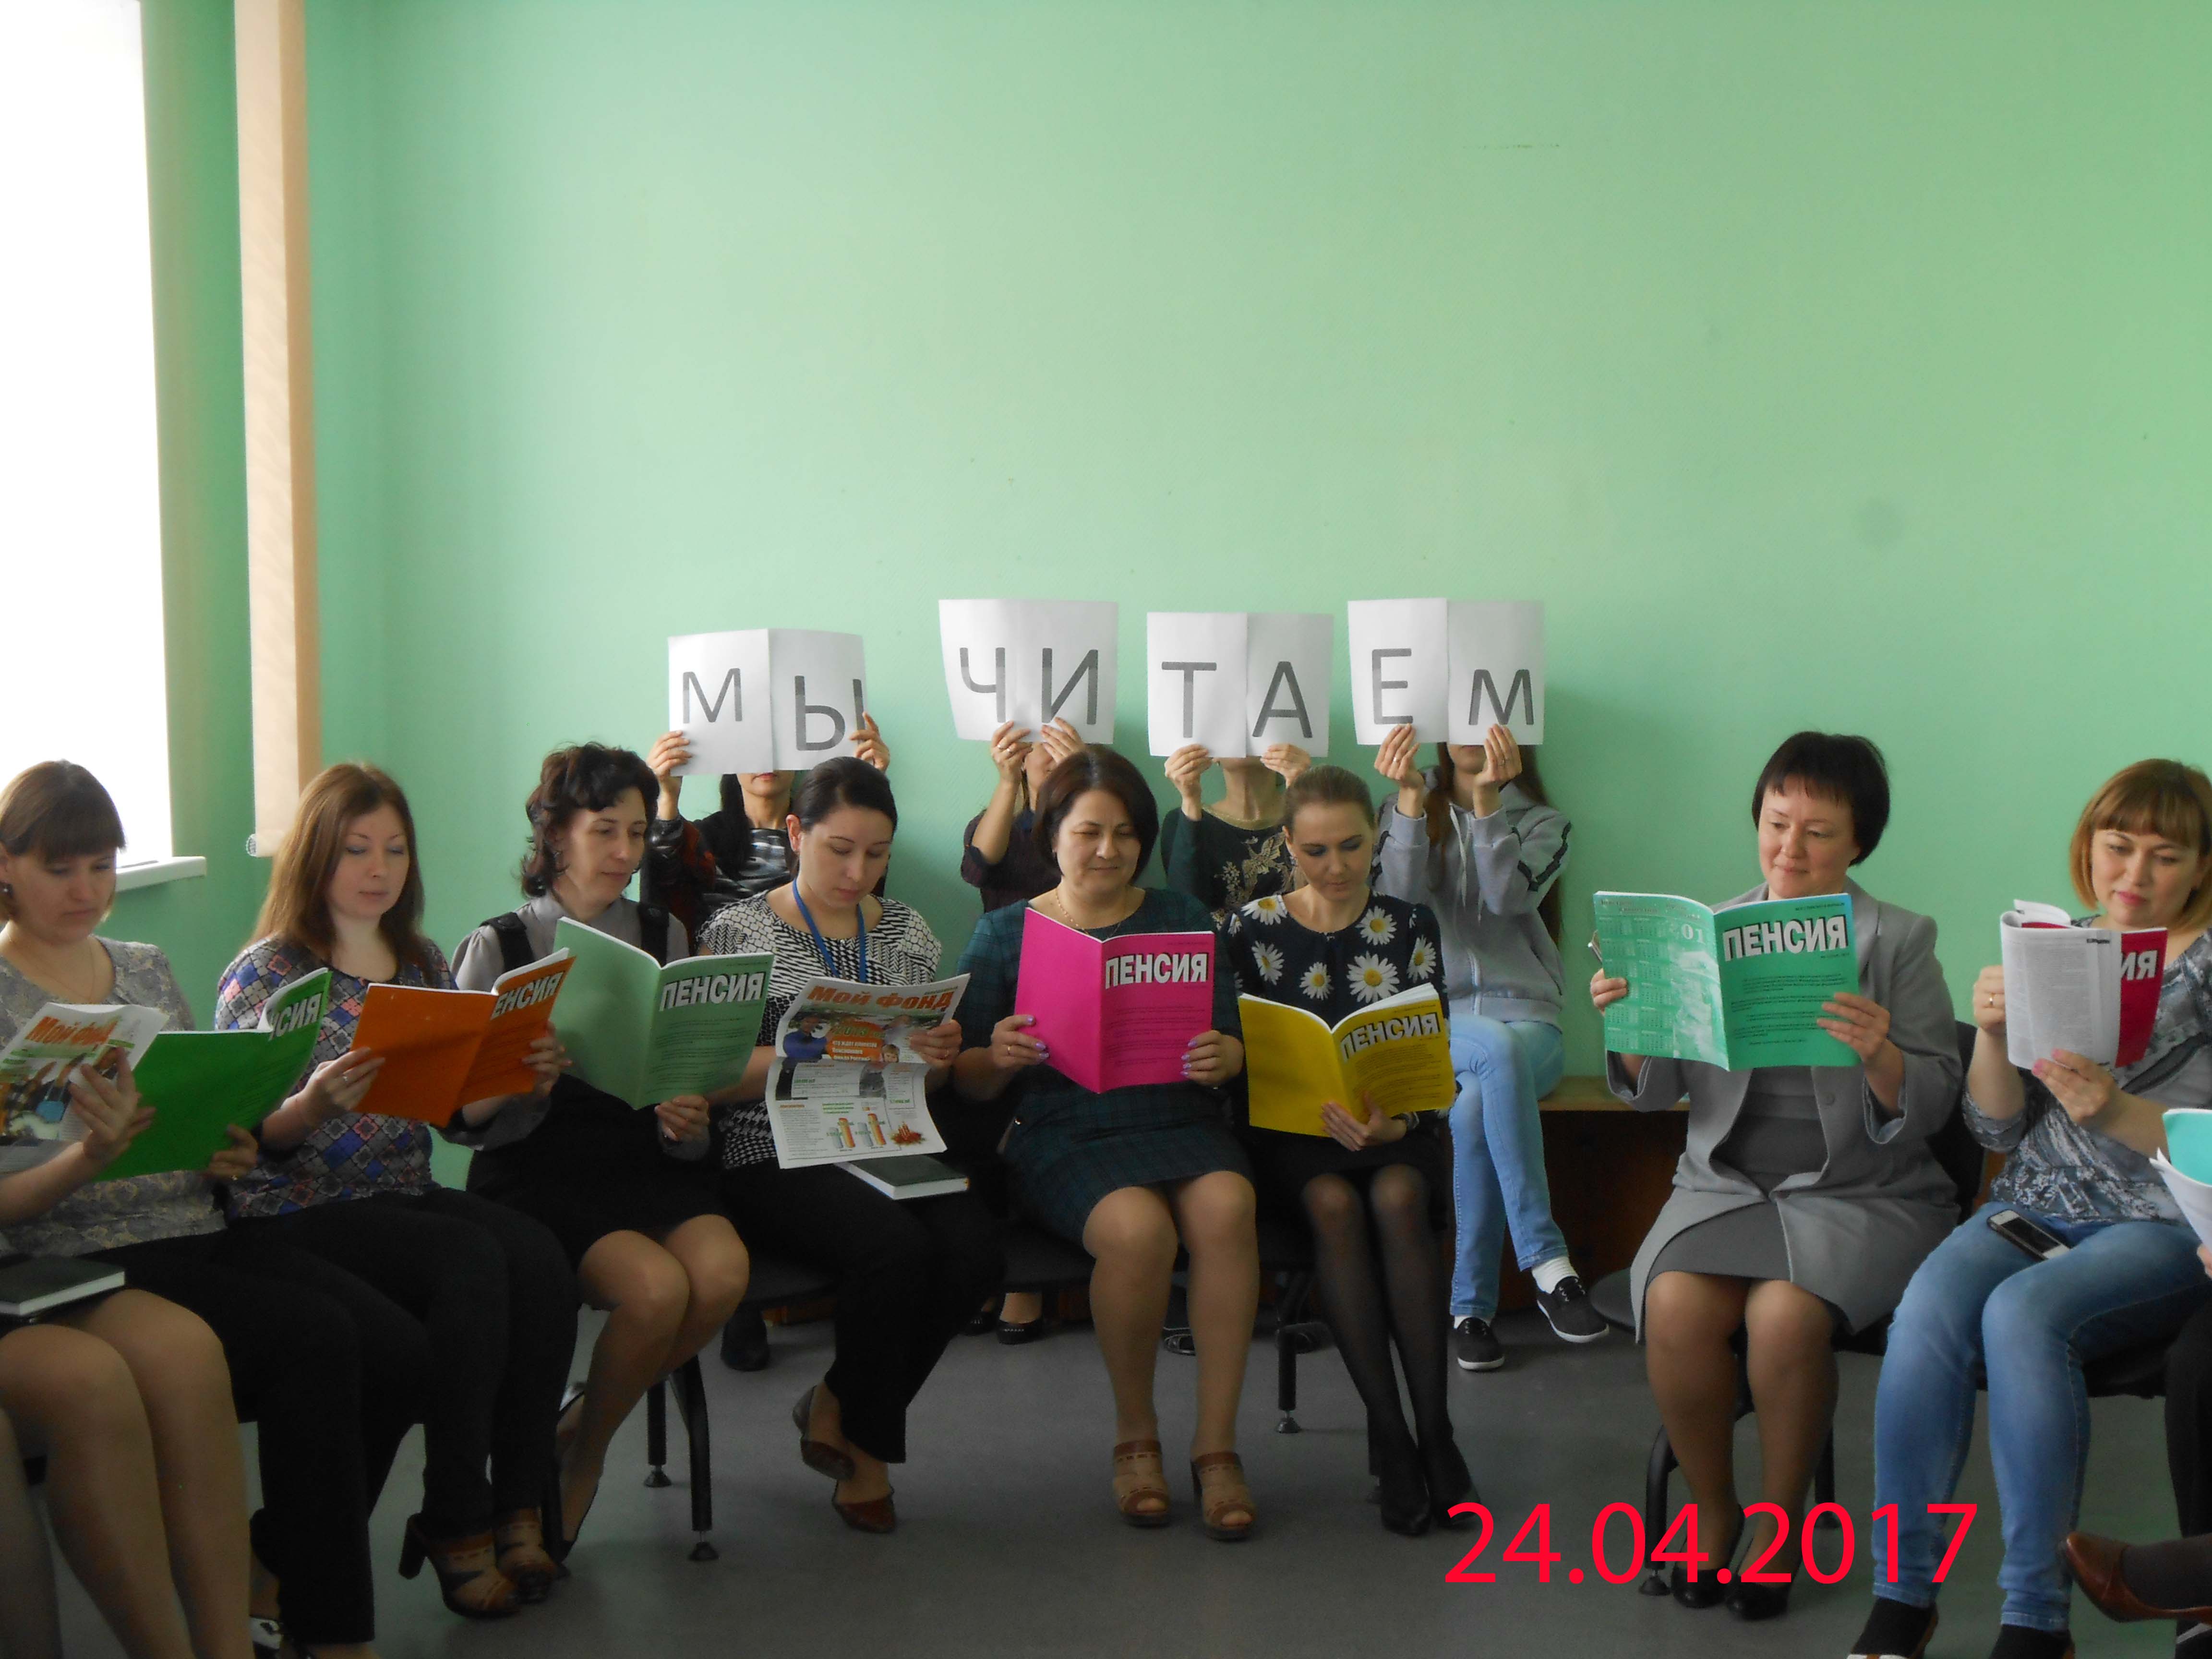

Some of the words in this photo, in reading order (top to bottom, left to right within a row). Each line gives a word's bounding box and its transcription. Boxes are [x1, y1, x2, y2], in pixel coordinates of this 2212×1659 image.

[682, 667, 866, 751] МЫ
[1722, 914, 1849, 962] ПЕНСИЯ
[659, 971, 766, 1012] ПЕНСИЯ
[1105, 952, 1209, 989] ПЕНСИЯ
[807, 986, 872, 1006] Мой
[1339, 1011, 1441, 1064] ПЕНСИЯ
